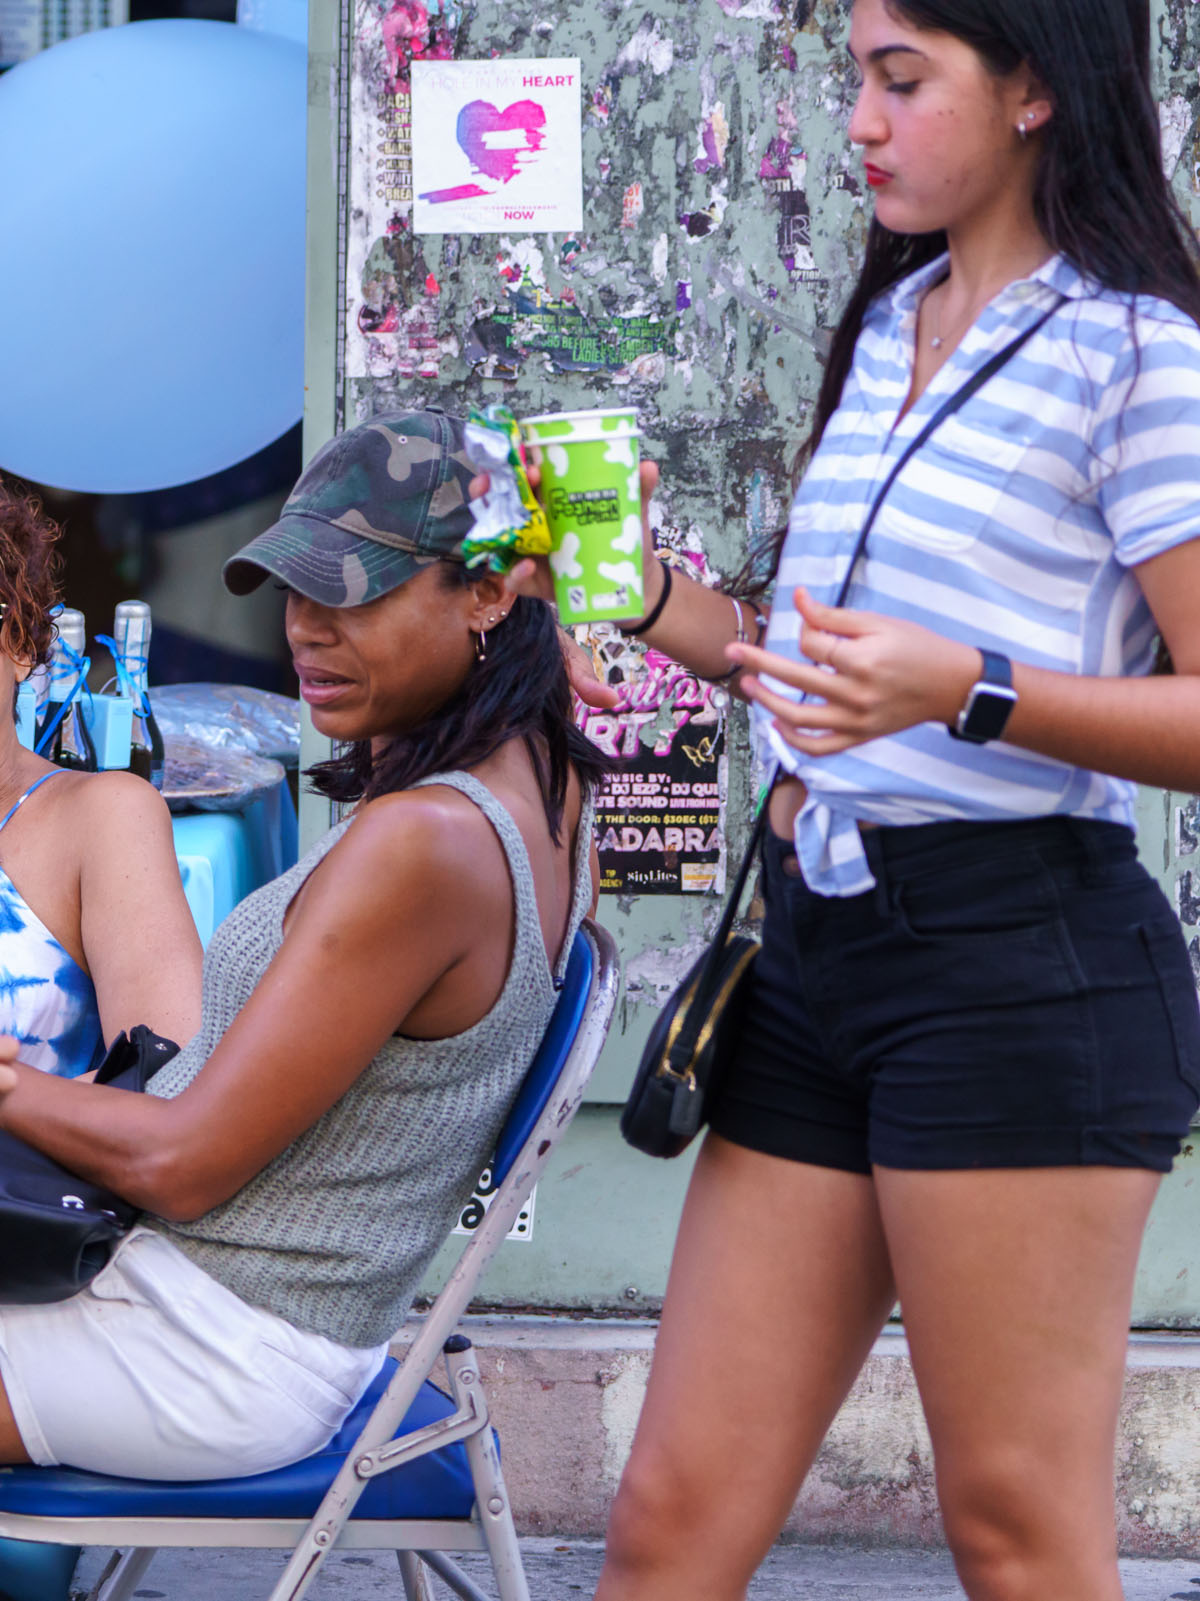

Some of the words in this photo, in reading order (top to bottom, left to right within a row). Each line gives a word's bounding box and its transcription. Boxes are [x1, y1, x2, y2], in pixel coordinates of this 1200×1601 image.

[522, 75, 575, 88] HEART
[504, 210, 535, 220] NOW
[562, 336, 599, 350] BEFORE
[572, 349, 605, 363] LADIES
[601, 773, 644, 783] MUSIC
[647, 773, 671, 783] BY:
[611, 783, 630, 795] DJ
[632, 783, 661, 795] EZP
[671, 783, 690, 796] DJ
[617, 796, 668, 808] SOUND
[605, 814, 625, 824] THE
[628, 815, 661, 824] DOOR:
